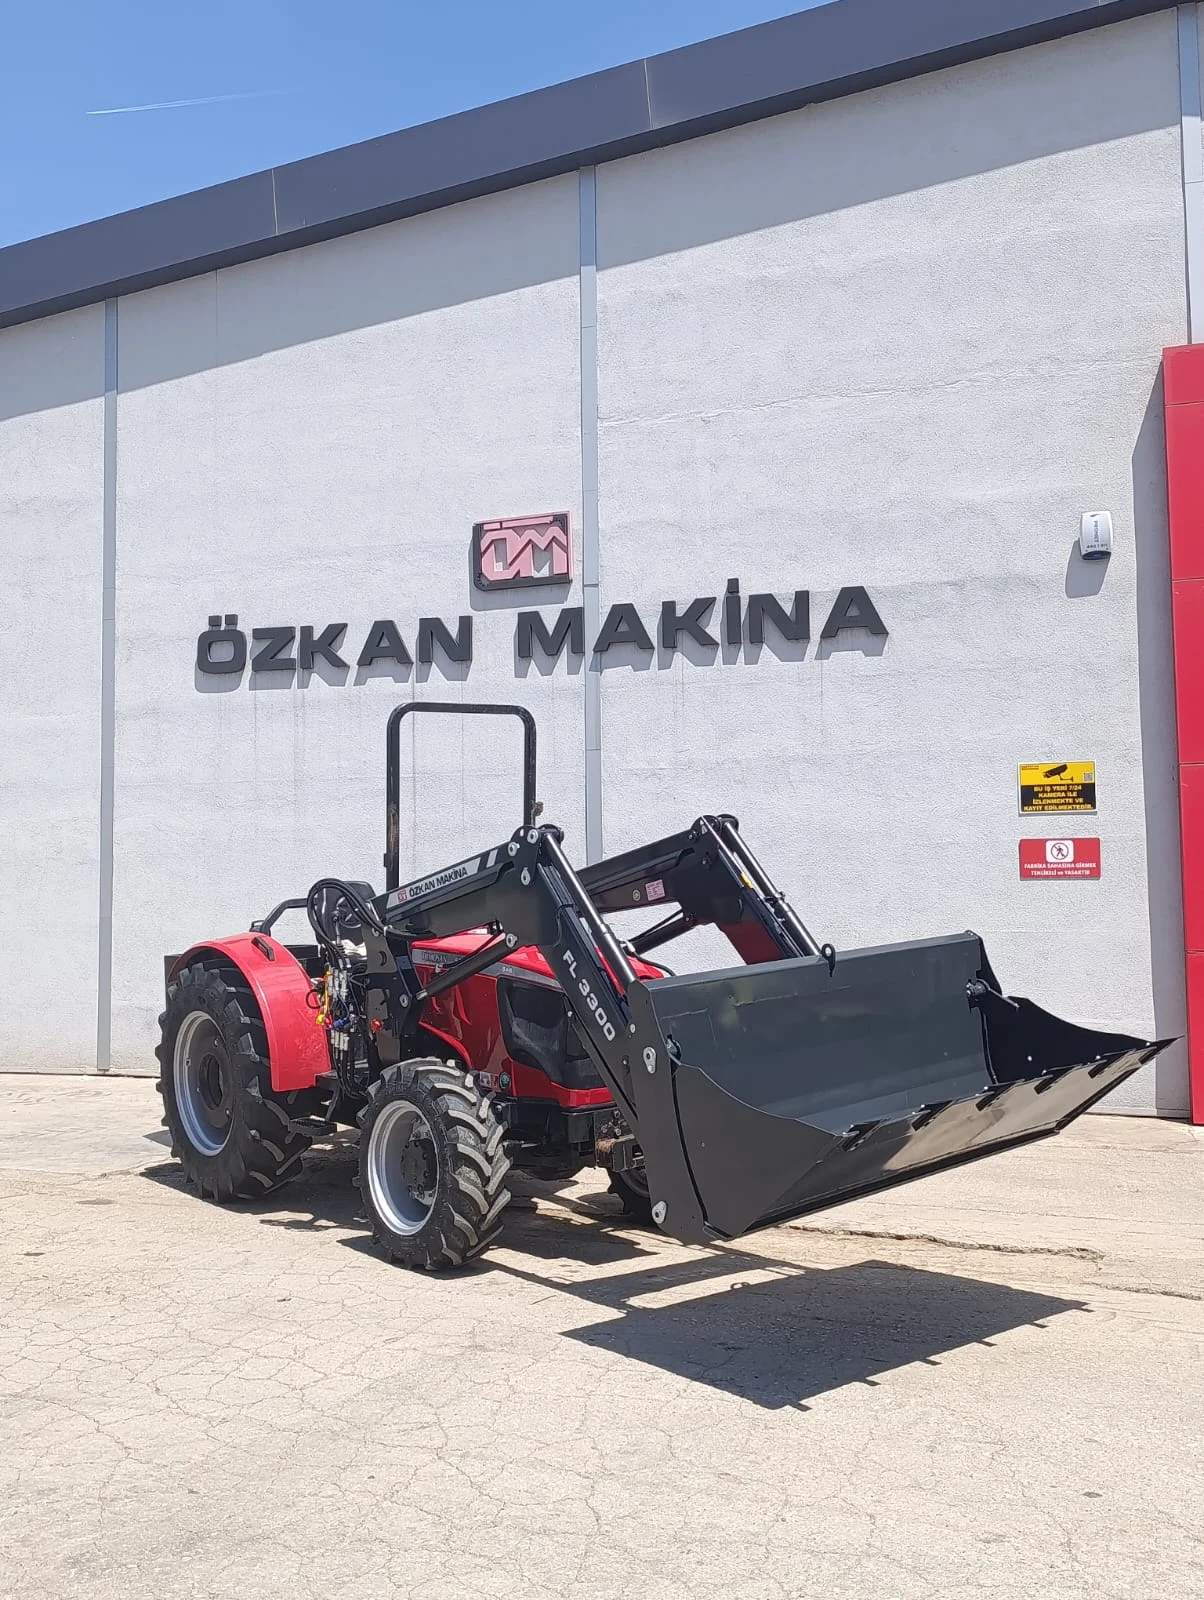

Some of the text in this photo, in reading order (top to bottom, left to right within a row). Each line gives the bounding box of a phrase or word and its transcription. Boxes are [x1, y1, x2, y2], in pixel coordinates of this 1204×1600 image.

[196, 577, 889, 675] ÖZKAN MAKİNA
[408, 879, 436, 898] ÖZKAN
[436, 866, 468, 887] MAKİNA
[562, 949, 616, 1042] FL 3300
